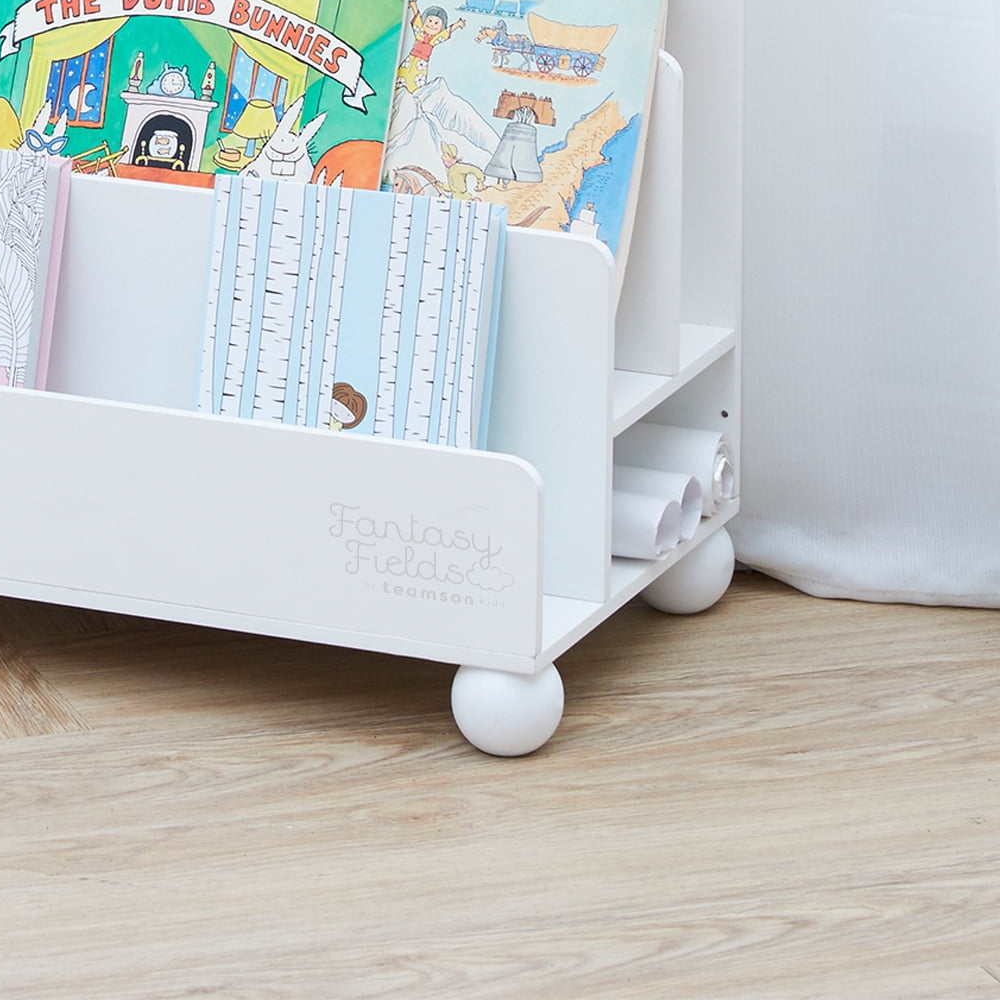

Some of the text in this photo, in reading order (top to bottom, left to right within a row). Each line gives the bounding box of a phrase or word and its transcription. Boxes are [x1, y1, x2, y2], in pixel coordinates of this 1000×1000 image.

[328, 502, 503, 570] Fantasy
[344, 539, 465, 585] Fields
[383, 581, 474, 605] teamson
